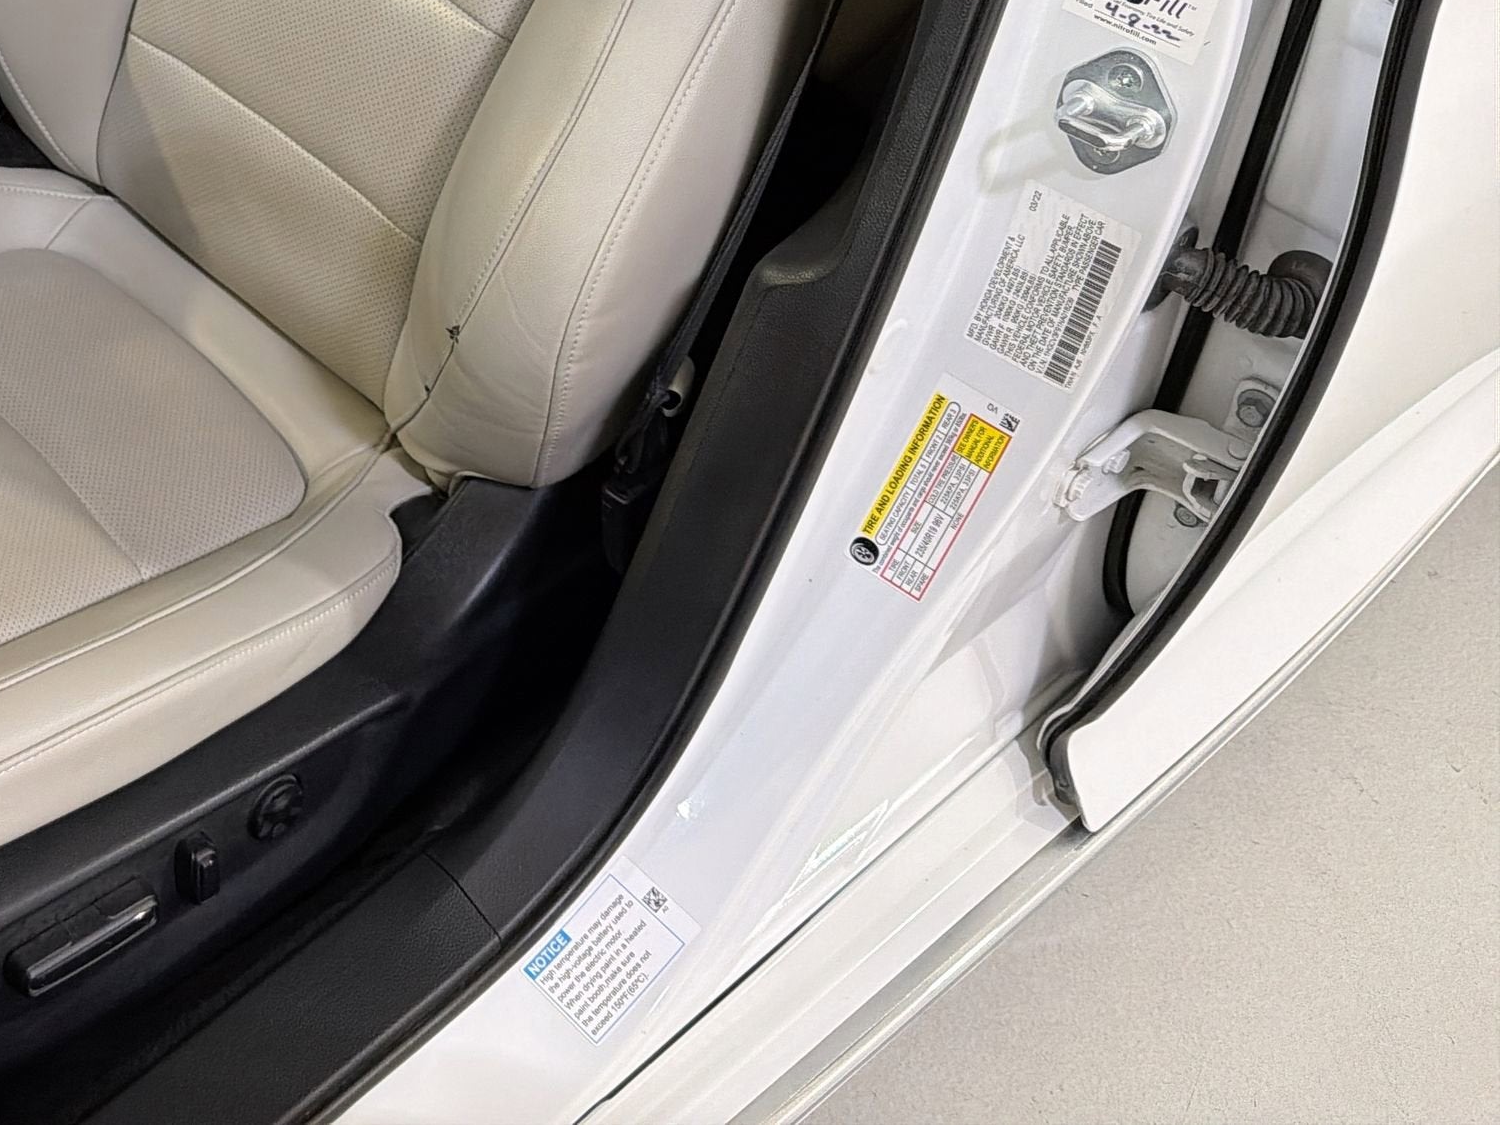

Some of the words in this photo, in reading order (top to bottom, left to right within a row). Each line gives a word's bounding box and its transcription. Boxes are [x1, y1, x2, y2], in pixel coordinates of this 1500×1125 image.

[1094, 14, 1157, 46] www.nitrofill.com
[1146, 12, 1156, 20] Tire
[1177, 26, 1195, 37] Safety
[1028, 190, 1043, 212] 03/22
[1049, 213, 1070, 254] APPLICABLE
[1072, 213, 1089, 241] EFFECT
[1070, 239, 1079, 249] IN
[1071, 242, 1088, 269] SHOWN
[1071, 274, 1084, 292] TYPE
[1078, 235, 1100, 275] PASSENGER
[1094, 221, 1106, 236] CAR
[1039, 265, 1049, 276] TO
[1044, 254, 1055, 267] ALL
[1052, 248, 1076, 288] STANDARDS
[973, 311, 983, 322] BY
[978, 289, 994, 312] HONDA
[988, 240, 1013, 289] DEVELOPMENT
[974, 287, 1003, 343] MANUFACTURING
[998, 277, 1007, 288] OF
[1014, 233, 1026, 248] LLC
[1050, 268, 1077, 318] MANUFACTURE
[1023, 275, 1045, 314] CONFORMS
[1012, 333, 1031, 363] FEDERAL
[1025, 307, 1042, 332] MOTOR
[1036, 278, 1054, 307] VEHICLE
[1035, 287, 1059, 331] PREVENTION
[981, 324, 996, 346] GVWR
[1011, 313, 1029, 342] VEHICLE
[1046, 317, 1056, 328] OF
[989, 329, 1004, 350] GAWR
[997, 333, 1011, 354] GAWR
[1026, 329, 1041, 351] THEFT
[1038, 327, 1052, 346] DATE
[1004, 342, 1016, 358] THIS
[1020, 351, 1031, 368] AND
[1032, 345, 1044, 359] THE
[1027, 359, 1038, 371] ON
[941, 413, 954, 429] REAR
[925, 440, 939, 459] FRONT
[956, 442, 967, 453] SEE
[965, 438, 982, 459] MANUAL
[976, 426, 987, 438] FOR
[974, 435, 995, 464] ADDITIONAL
[983, 435, 1006, 469] INFORMATION
[862, 513, 880, 534] TIRE
[875, 494, 890, 515] AND
[885, 455, 913, 495] LOADING
[907, 394, 946, 456] INFORMATION
[909, 469, 924, 486] TOTAL
[928, 489, 939, 504] COLD
[934, 480, 945, 490] TIRE
[940, 454, 959, 482] PRESSURE
[879, 516, 896, 541] SEATING
[892, 490, 911, 518] CAPACITY
[912, 497, 920, 508] and
[910, 520, 922, 534] SIZE
[950, 512, 964, 530] NONE
[888, 558, 900, 571] TIRE
[896, 560, 910, 581] FRONT
[905, 570, 918, 587] REAR
[914, 573, 929, 592] SPARE
[539, 969, 557, 985] High
[553, 933, 589, 971] temperature
[587, 918, 602, 935] may
[600, 894, 624, 921] damage
[548, 982, 560, 994] the
[557, 945, 594, 984] high-voltage
[591, 923, 614, 947] battery
[611, 906, 628, 925] used
[624, 900, 634, 909] to
[527, 933, 568, 976] NOTICE
[564, 990, 585, 1010] When
[582, 971, 603, 992] drying
[600, 954, 617, 974] paint
[613, 948, 623, 957] in
[624, 919, 647, 945] heated
[557, 981, 576, 1003] power
[574, 971, 586, 983] the
[585, 948, 607, 972] electric
[573, 1000, 591, 1021] paint
[620, 951, 635, 967] sure
[581, 1015, 594, 1027] the
[591, 978, 627, 1017] temperature
[625, 962, 642, 980] does
[640, 950, 652, 964] not
[591, 1010, 614, 1036] exceed
